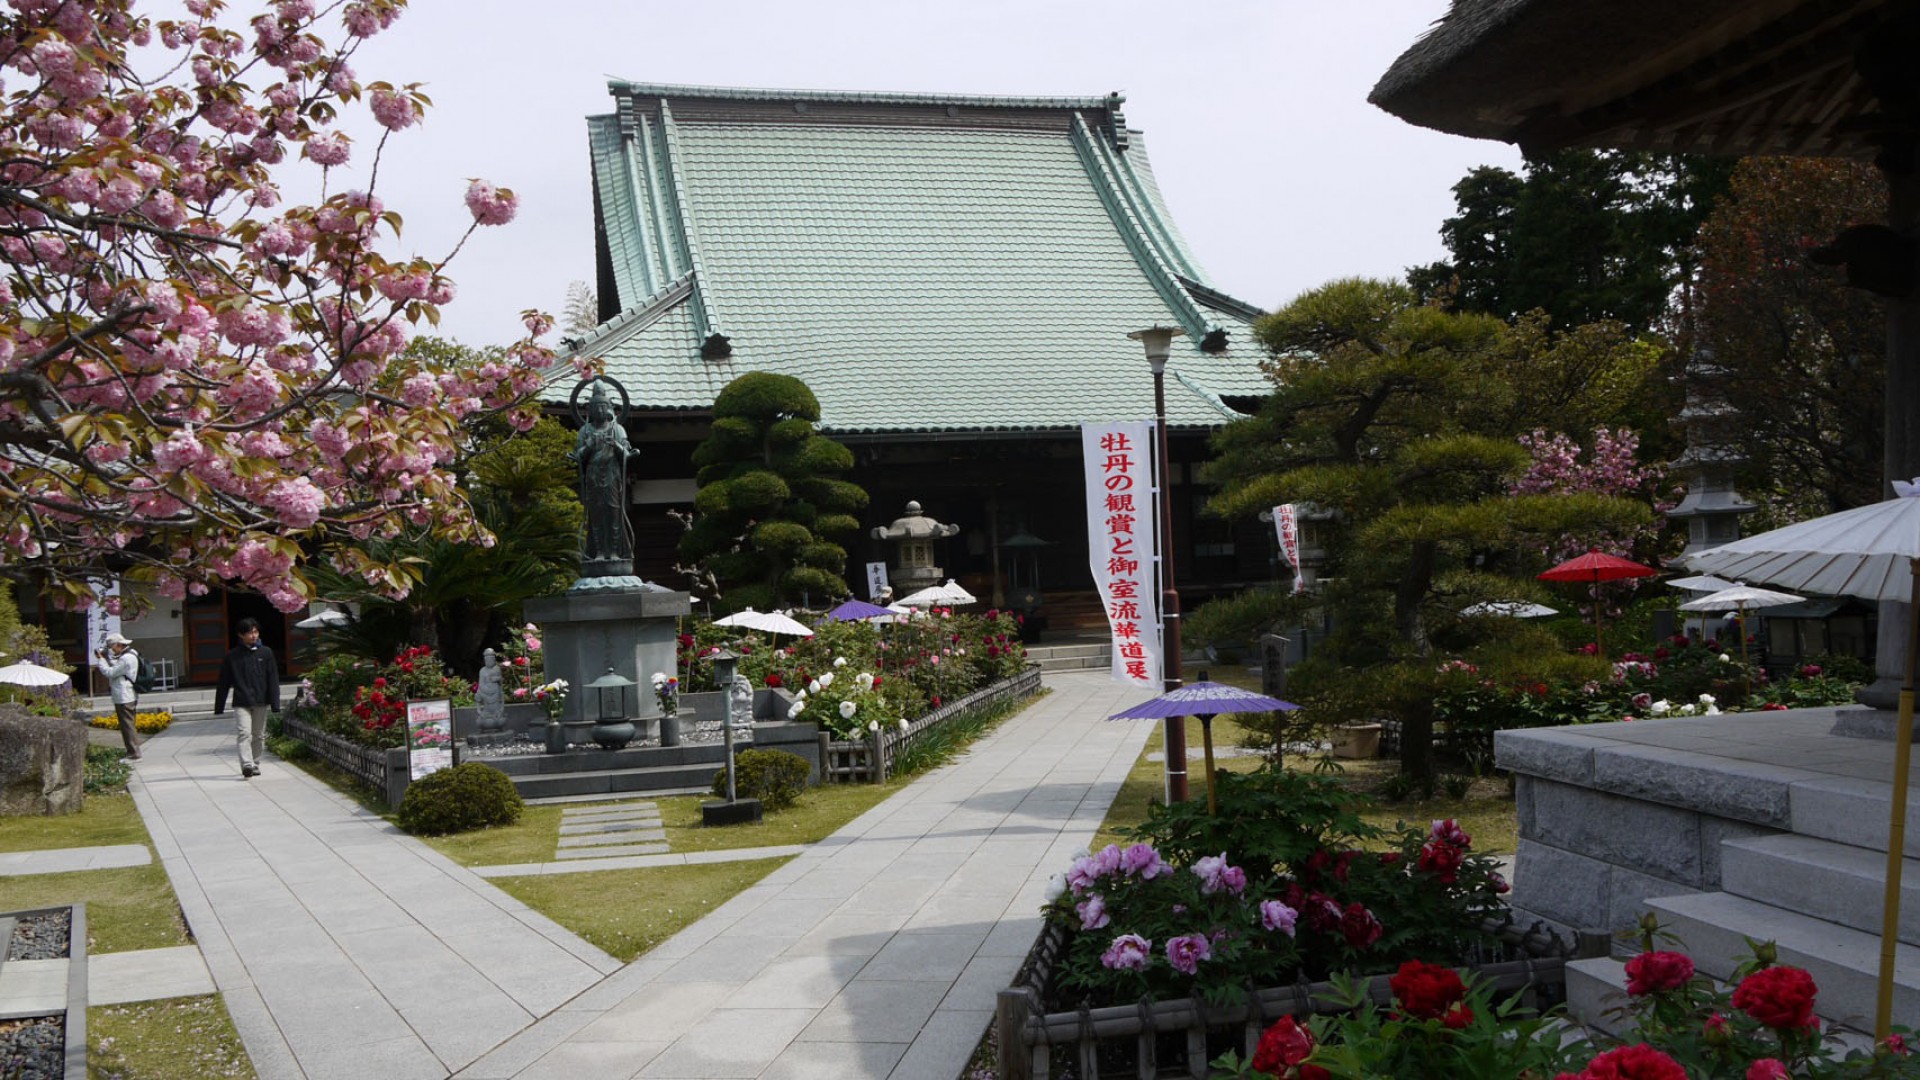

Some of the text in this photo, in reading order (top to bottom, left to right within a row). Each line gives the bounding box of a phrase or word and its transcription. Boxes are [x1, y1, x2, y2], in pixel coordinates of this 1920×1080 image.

[1100, 432, 1149, 680] 牡丹の観賞と御室流華道展
